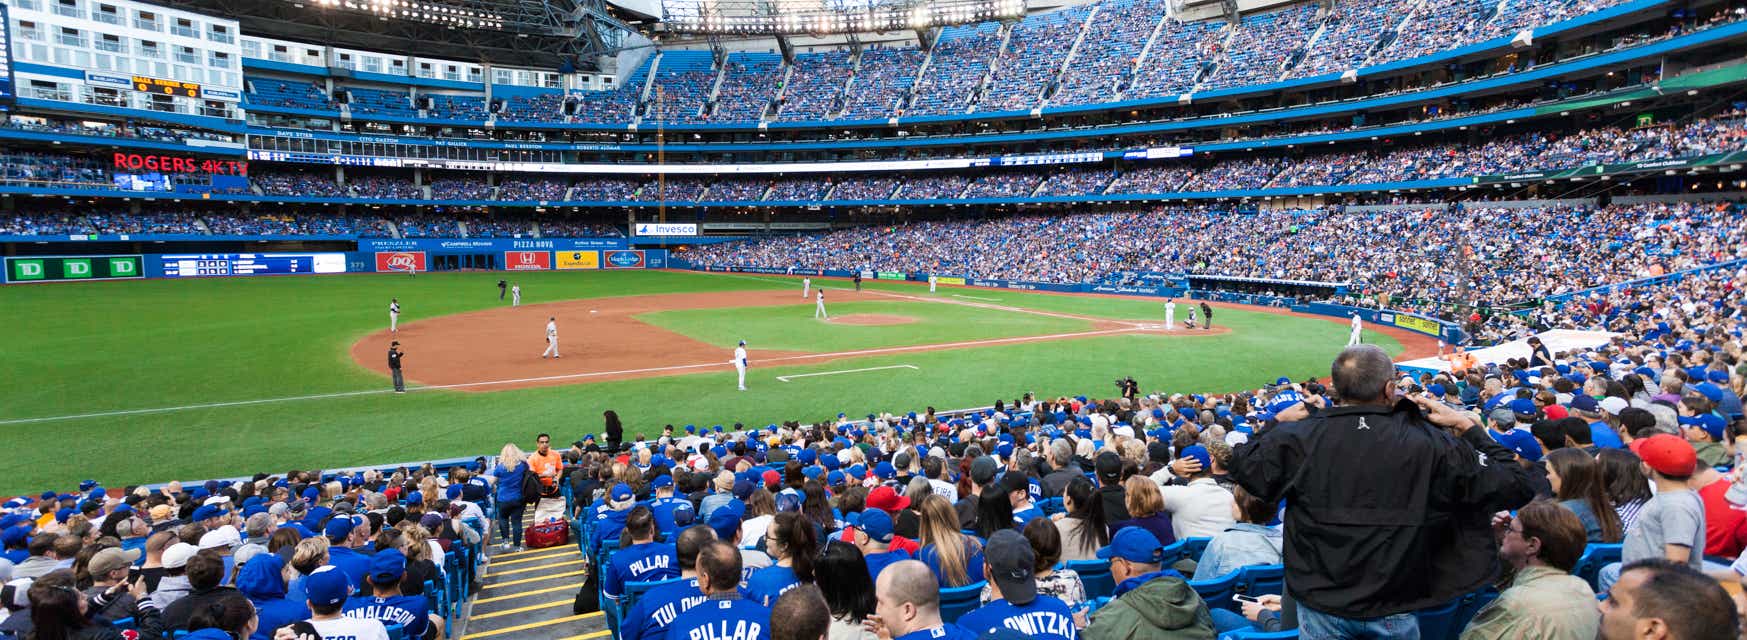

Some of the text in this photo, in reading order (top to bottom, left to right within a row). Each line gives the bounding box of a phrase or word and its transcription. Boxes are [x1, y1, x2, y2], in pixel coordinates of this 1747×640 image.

[132, 76, 152, 84] BALL
[114, 152, 196, 172] ROGERS
[112, 261, 133, 273] TD
[392, 256, 411, 266] DQ
[17, 263, 41, 275] TD
[66, 262, 88, 274] TD
[629, 555, 669, 576] PILLAR
[690, 620, 760, 640] PILLAR
